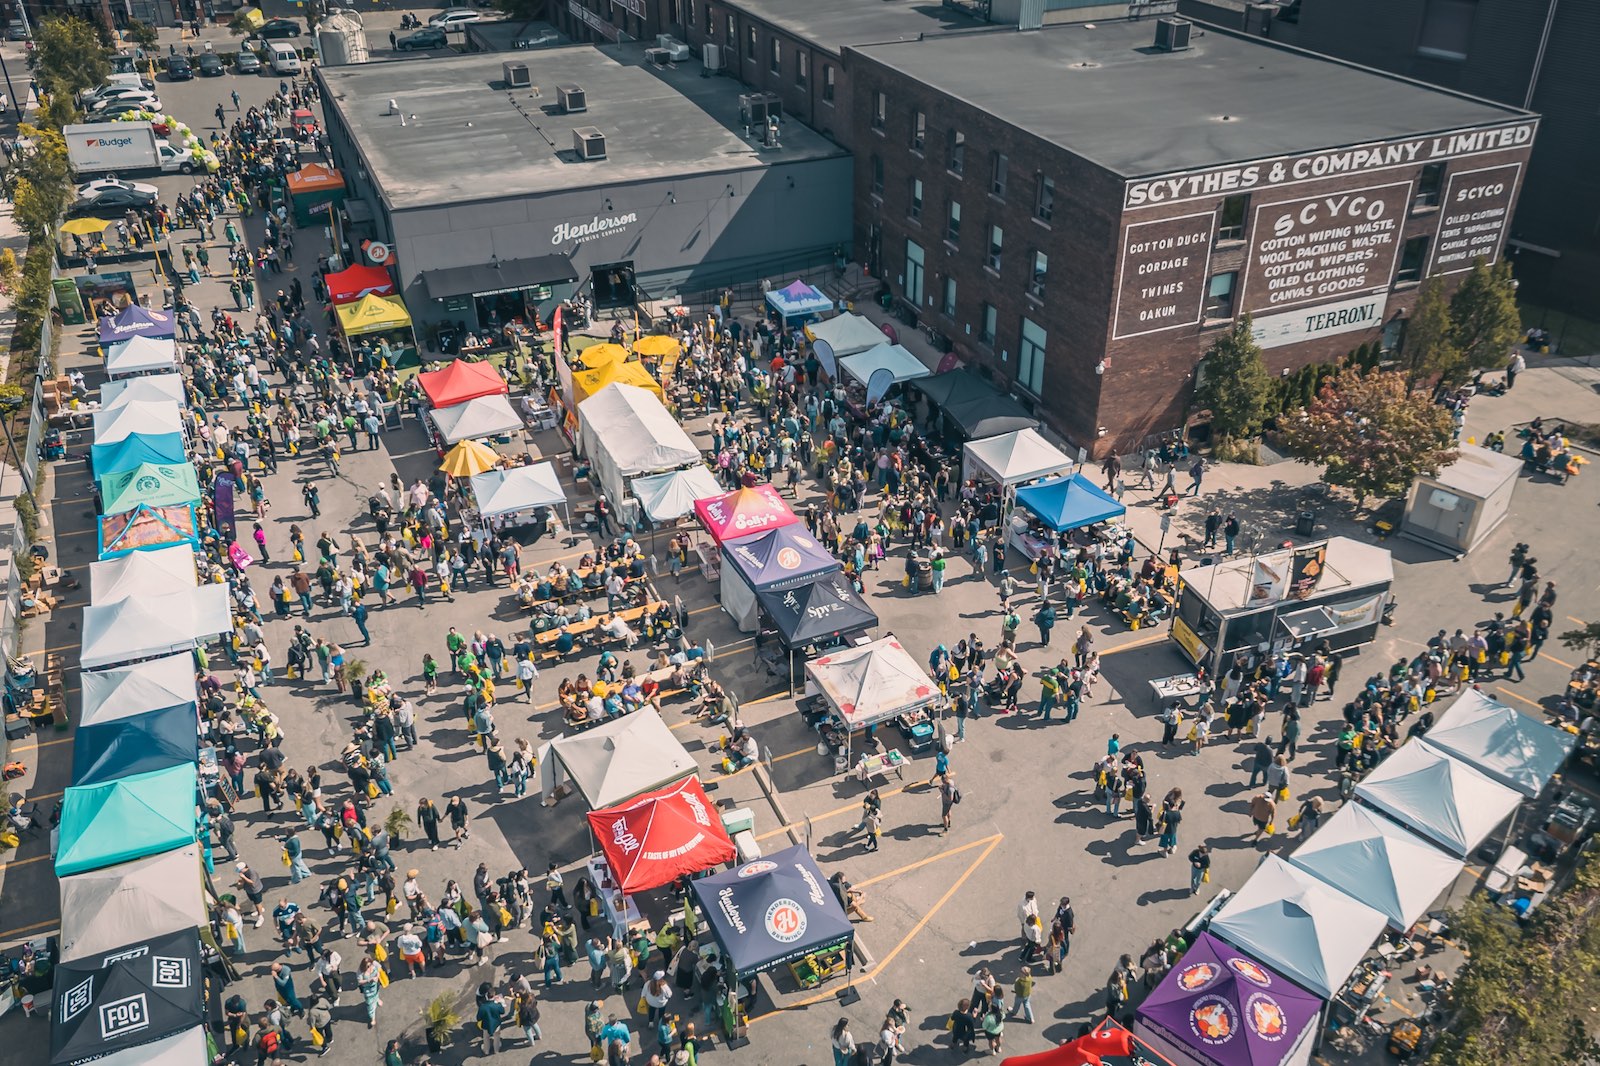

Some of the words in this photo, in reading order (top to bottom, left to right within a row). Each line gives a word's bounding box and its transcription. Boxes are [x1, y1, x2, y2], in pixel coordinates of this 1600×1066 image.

[98, 137, 132, 148] Budget
[1127, 166, 1260, 205] SCYTHES
[1268, 162, 1287, 183] &
[1292, 141, 1425, 179] COMPANY
[1428, 125, 1531, 158] LIMITED
[1456, 183, 1504, 202] SCYCO
[1273, 195, 1385, 237] SCYCO
[1445, 213, 1471, 226] OILED
[1471, 207, 1505, 221] CLOTHING
[551, 212, 637, 245] Henderson
[575, 234, 600, 244] BREWING
[601, 226, 626, 237] COMPANY
[1260, 234, 1306, 252] COTTON
[1308, 226, 1351, 243] WIPING
[1354, 218, 1396, 235] WASTE,
[1441, 227, 1461, 239] TENTS
[1463, 220, 1503, 235] TARPAULINS
[1129, 237, 1173, 254] COTTON
[1176, 232, 1207, 247] DUCK
[1441, 238, 1469, 251] CANVAS
[1470, 233, 1498, 246] GOODS
[1259, 250, 1292, 266] WOOL
[1296, 240, 1347, 259] PACKING
[1468, 246, 1492, 258] FLAGS
[1138, 257, 1189, 275] CORDAGE
[1264, 259, 1314, 278] COTTON
[1141, 281, 1184, 299] TWINES
[1268, 275, 1300, 291] OILED
[1269, 285, 1313, 303] CANVAS
[1317, 276, 1365, 294] GOODS
[1140, 304, 1176, 321] OAKUM
[1305, 303, 1376, 333] TERRONI
[113, 321, 154, 334] Henderson
[735, 514, 777, 529] Solly's
[795, 863, 825, 905] Henderson
[718, 887, 747, 934] Henderson
[766, 899, 800, 921] HENDERSON
[771, 930, 802, 942] BREWING
[158, 960, 180, 983] FOC
[70, 983, 87, 1013] FOC
[107, 1001, 139, 1029] FOC
